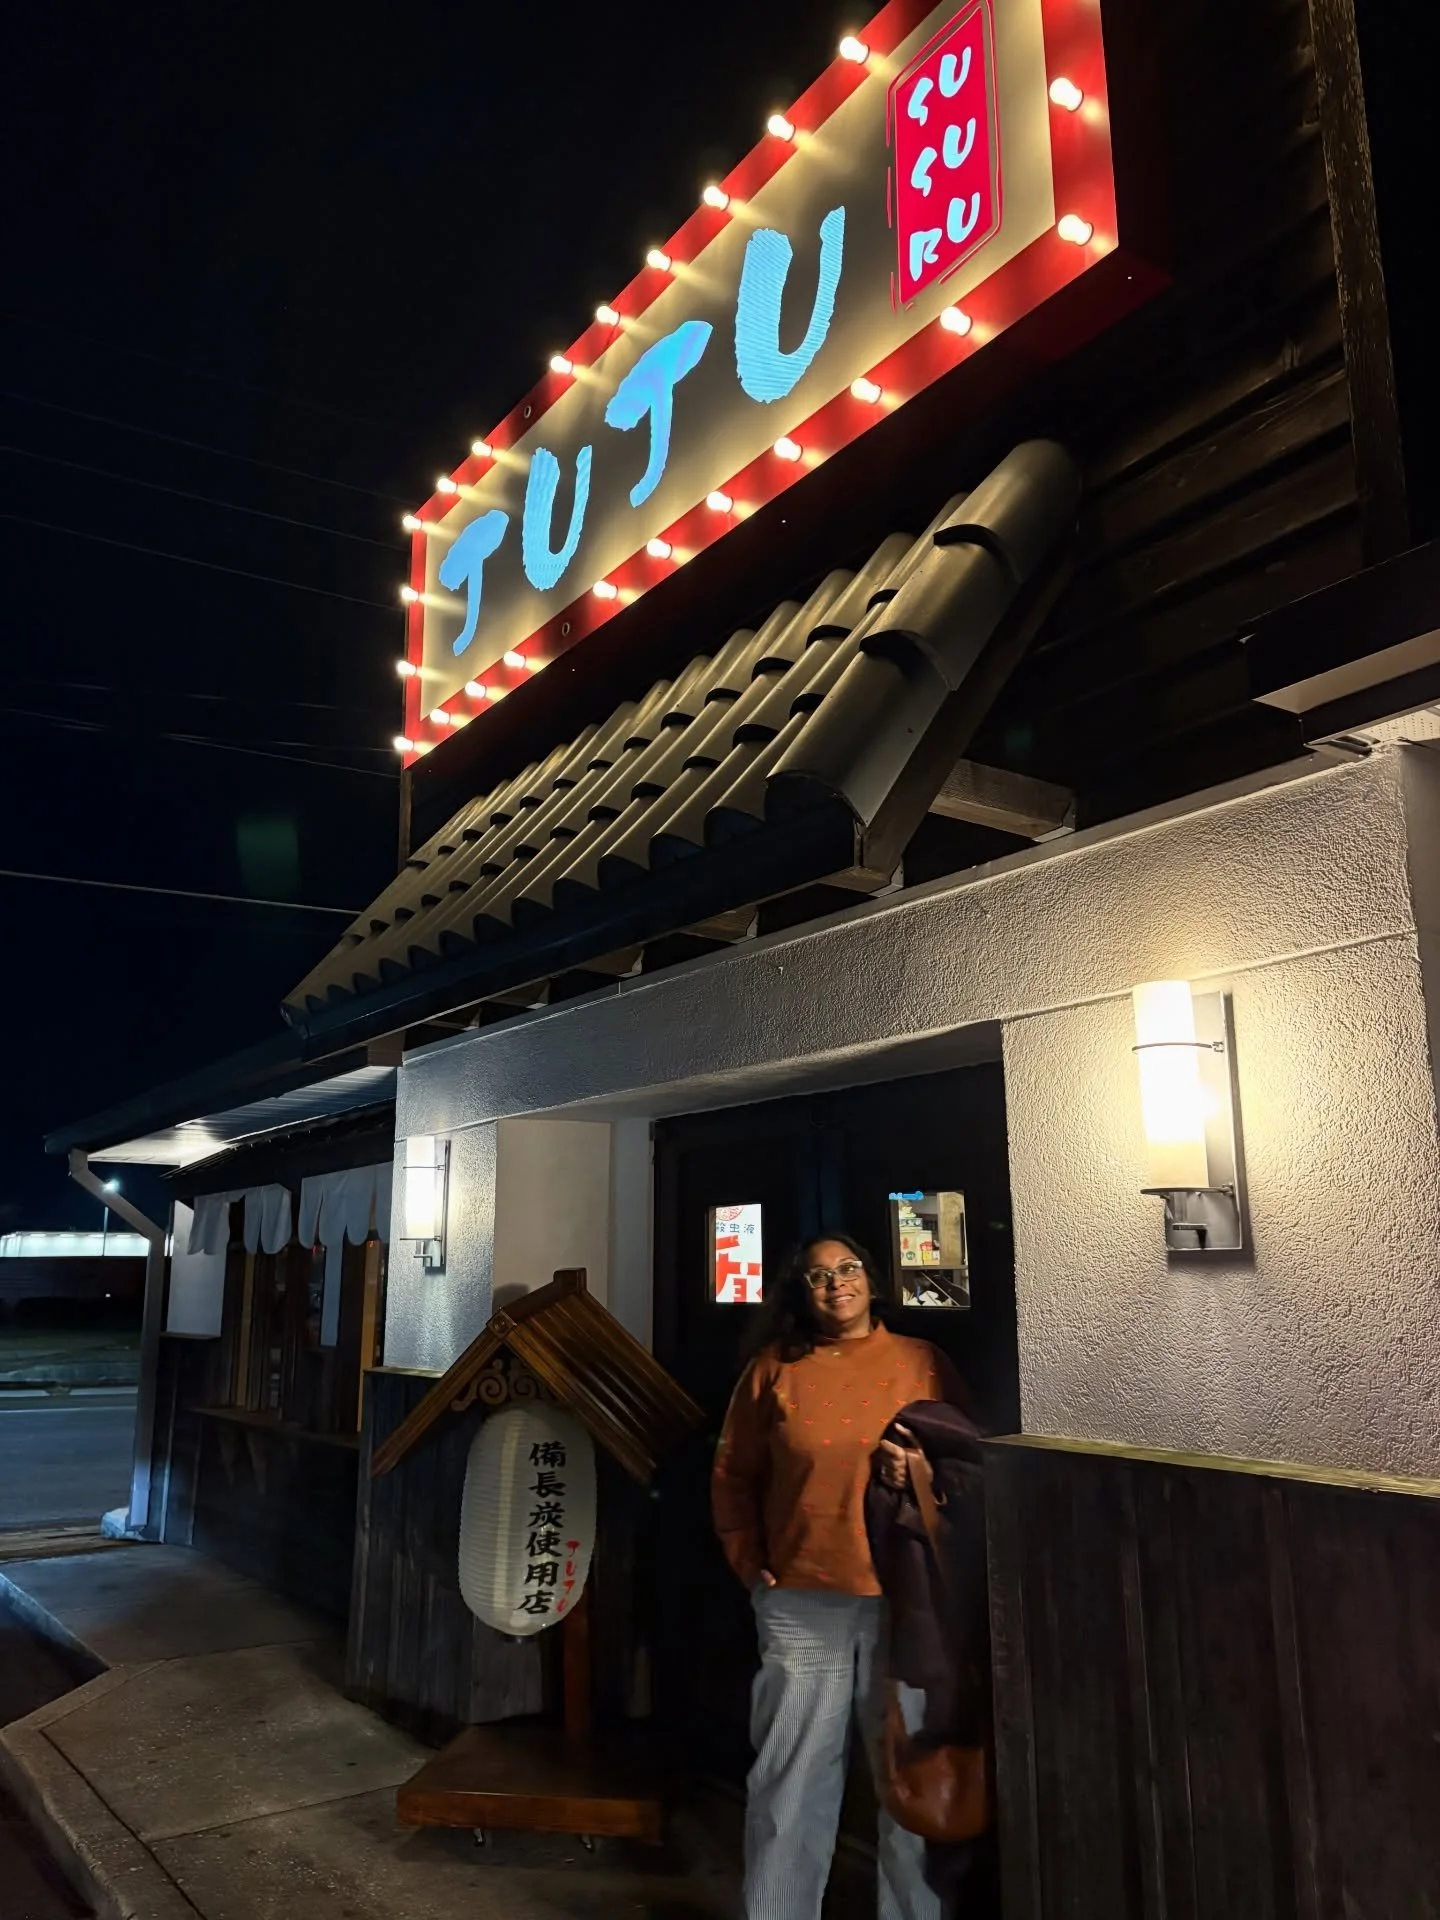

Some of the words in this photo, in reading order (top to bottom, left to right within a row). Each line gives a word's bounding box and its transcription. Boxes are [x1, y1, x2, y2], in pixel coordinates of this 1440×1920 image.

[908, 46, 972, 126] SU
[911, 118, 976, 197] SU
[909, 192, 980, 281] RU
[438, 206, 846, 657] TUTU
[516, 1441, 567, 1615] 備長炭使用店
